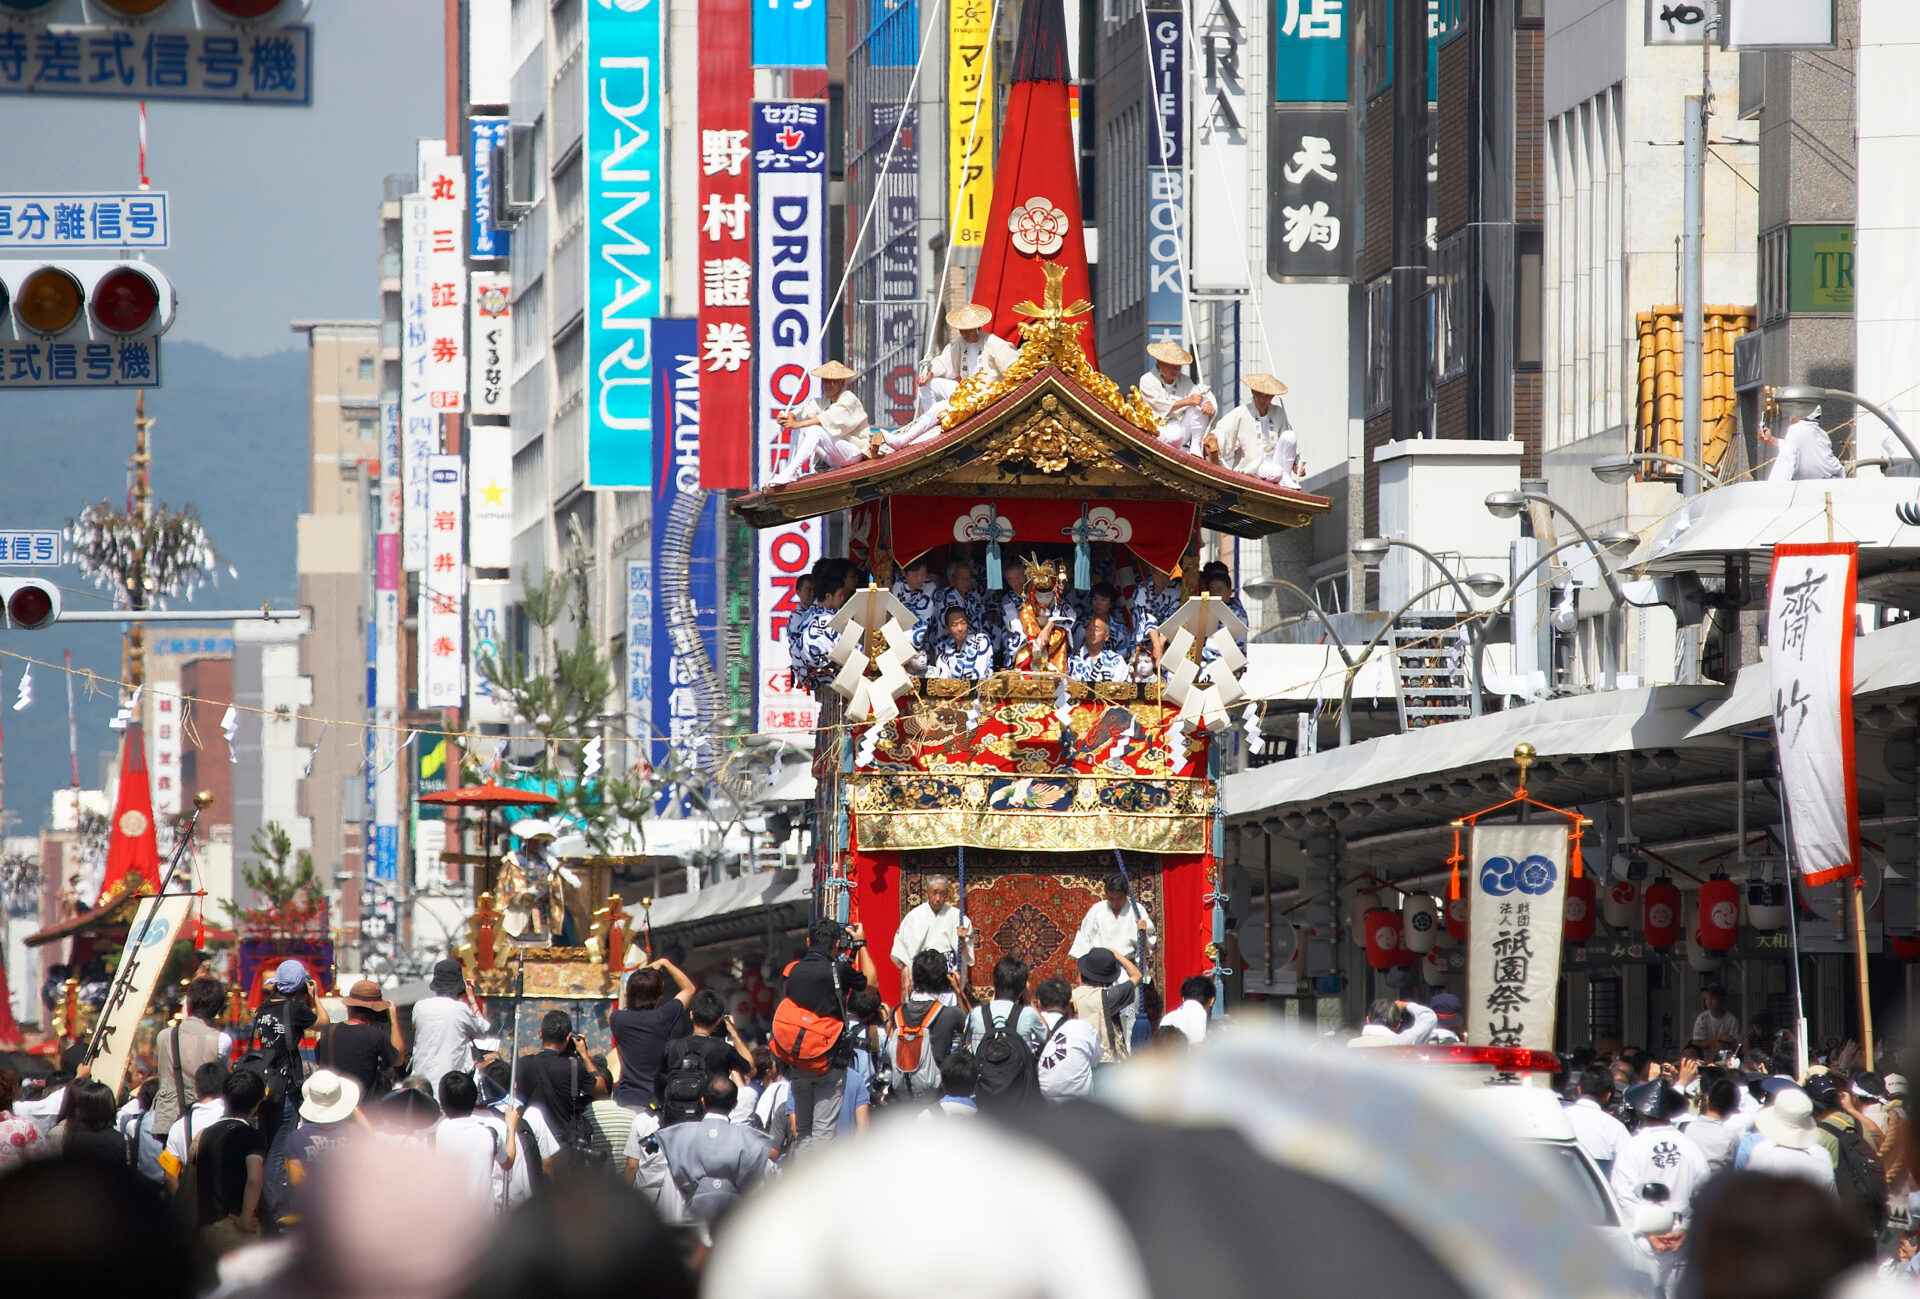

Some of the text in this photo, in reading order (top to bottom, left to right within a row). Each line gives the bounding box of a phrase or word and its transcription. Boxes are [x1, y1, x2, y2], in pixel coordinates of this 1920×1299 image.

[761, 105, 818, 125] セガミ
[755, 149, 824, 169] チェーン
[1282, 135, 1341, 253] 天狗
[431, 174, 458, 361] 丸三証券
[599, 56, 650, 431] DAIMARU
[702, 129, 750, 370] 野村證券
[961, 228, 981, 242] 8F
[1150, 171, 1182, 293] BOOK
[772, 196, 809, 348] DRUG
[0, 343, 150, 381] 式信号機
[766, 709, 813, 729] 化粧品
[768, 674, 811, 694] くす
